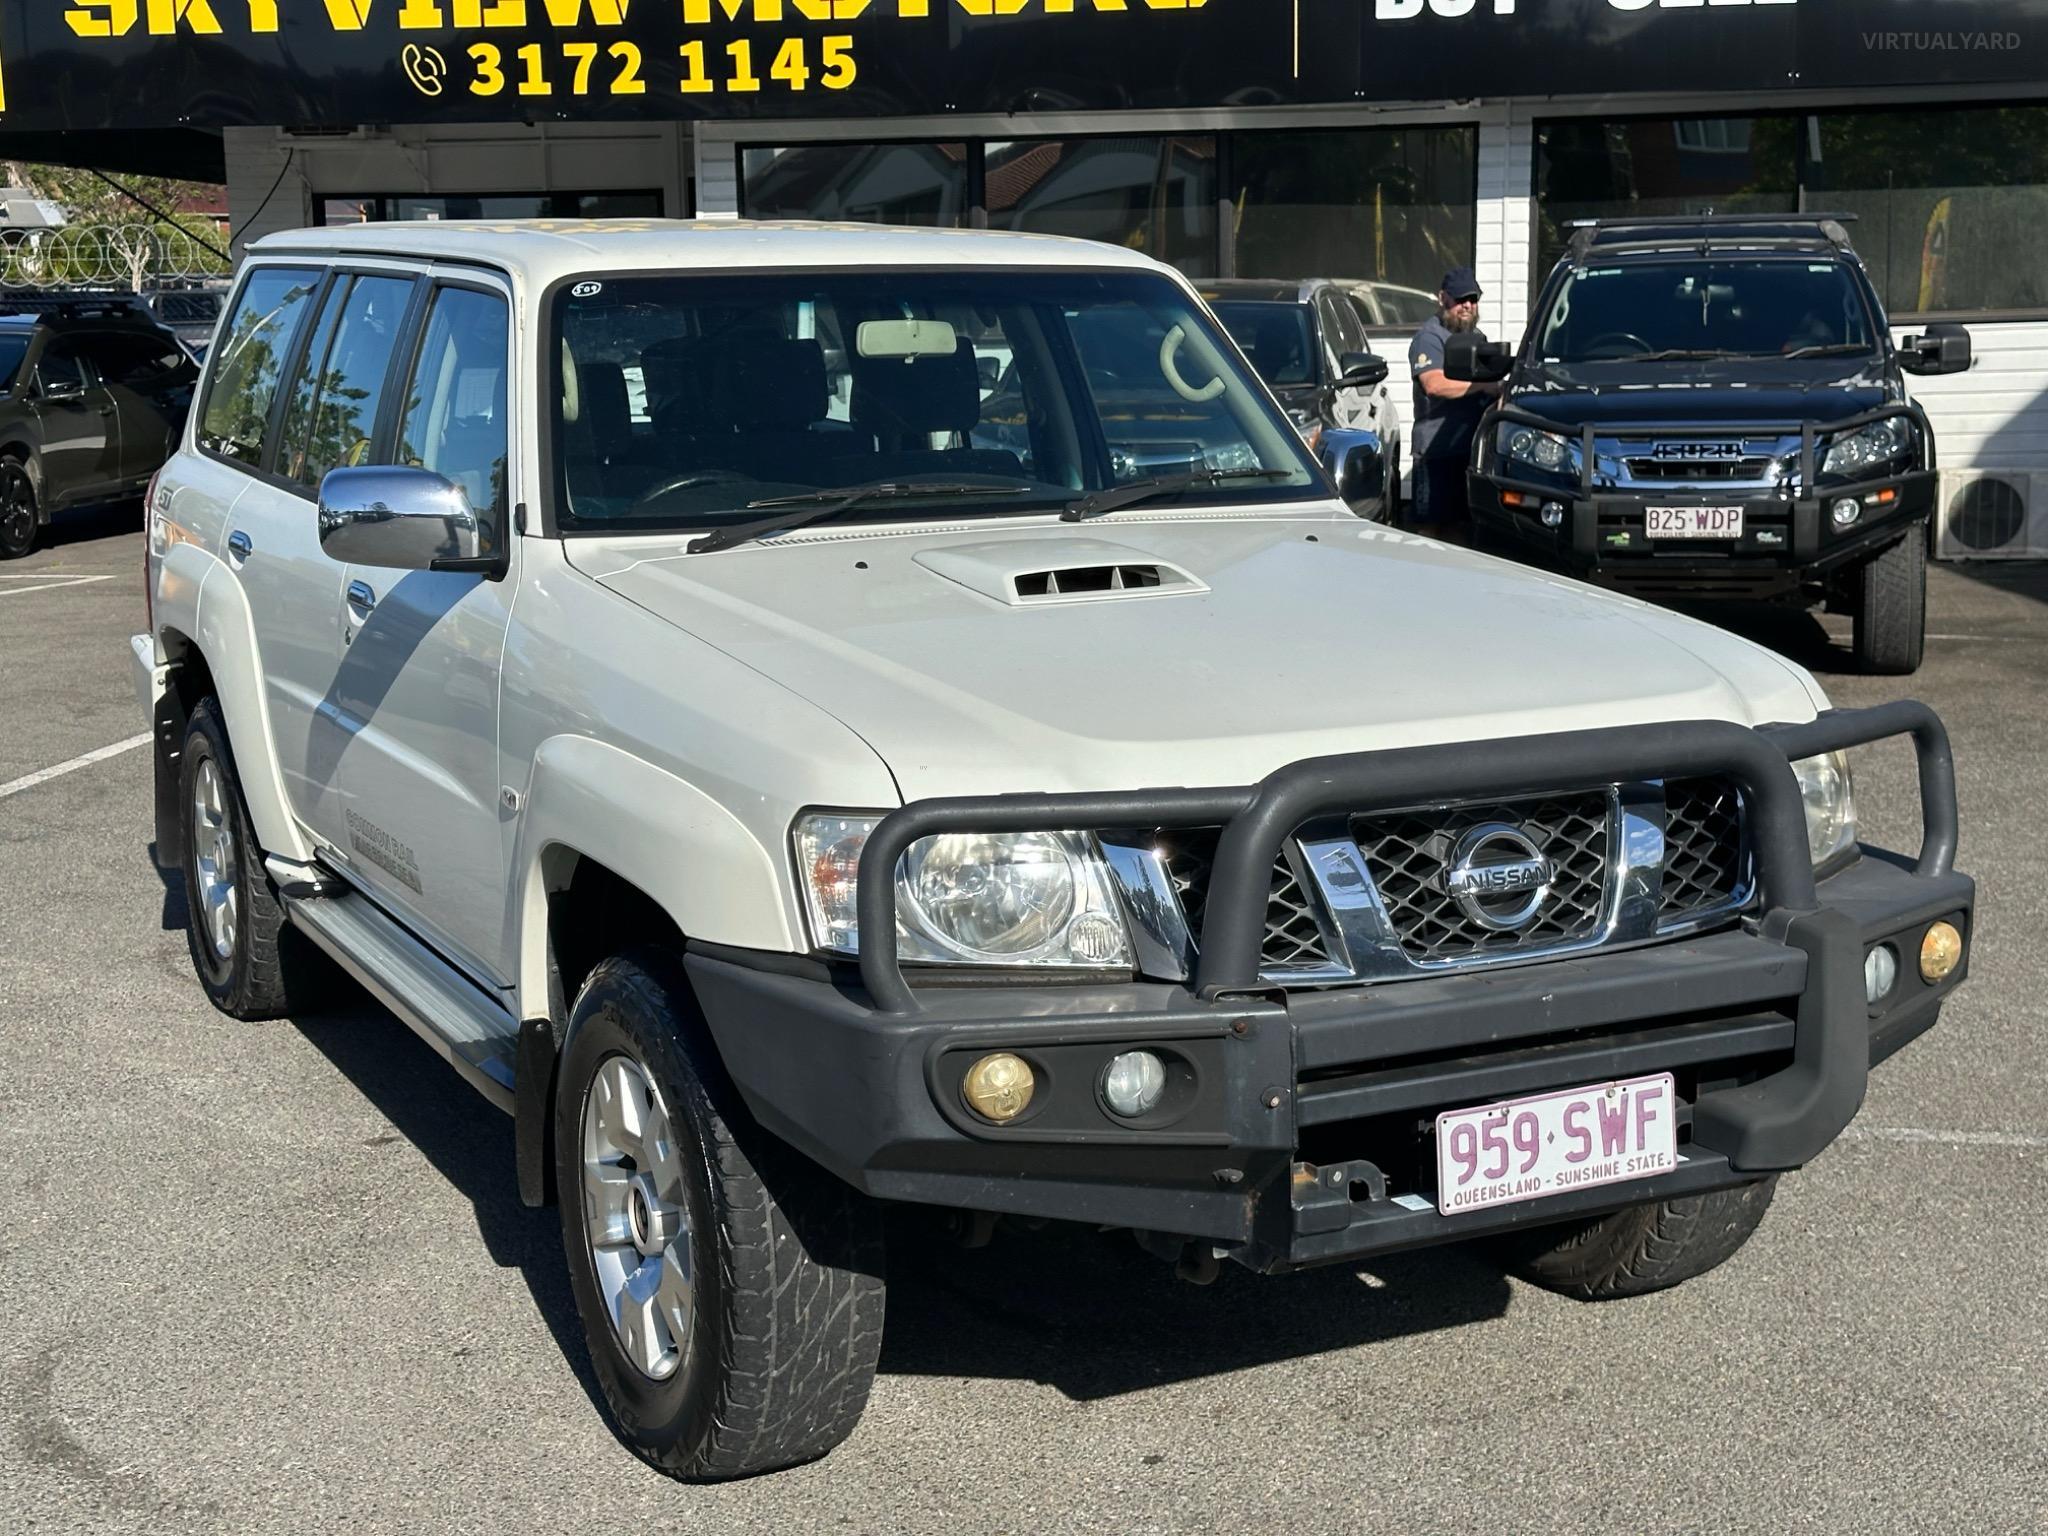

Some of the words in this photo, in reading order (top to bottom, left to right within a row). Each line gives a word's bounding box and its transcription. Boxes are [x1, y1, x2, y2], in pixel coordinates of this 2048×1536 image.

[469, 41, 646, 96] 3172
[679, 35, 857, 92] 1145
[1658, 444, 1737, 459] ISUZU
[1649, 510, 1686, 530] 825
[1696, 510, 1739, 530] WDP
[1466, 865, 1549, 889] NISSAN
[1450, 1111, 1540, 1186] 959
[1563, 1086, 1663, 1163] SWF
[1454, 1177, 1541, 1206] QUEENSLAND
[1556, 1161, 1620, 1186] SUNSHINE
[1627, 1152, 1664, 1172] STATE
